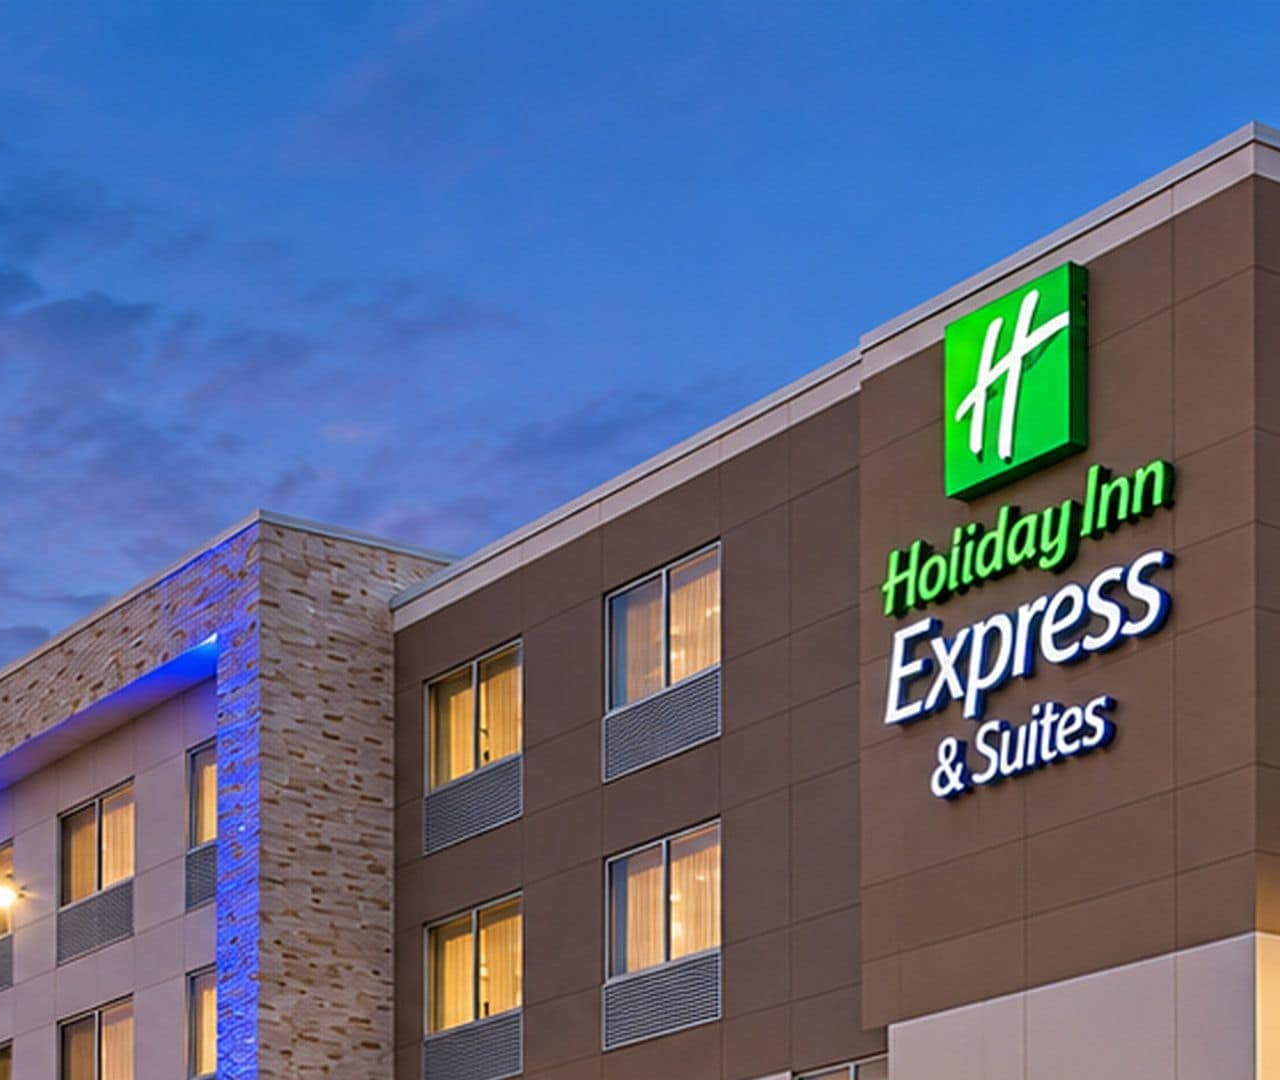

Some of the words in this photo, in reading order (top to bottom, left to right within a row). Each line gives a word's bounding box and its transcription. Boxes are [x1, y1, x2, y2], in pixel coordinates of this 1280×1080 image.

[1079, 459, 1166, 538] Inn
[883, 550, 1166, 725] Express
[930, 736, 965, 798] &
[971, 695, 1108, 784] Suites
